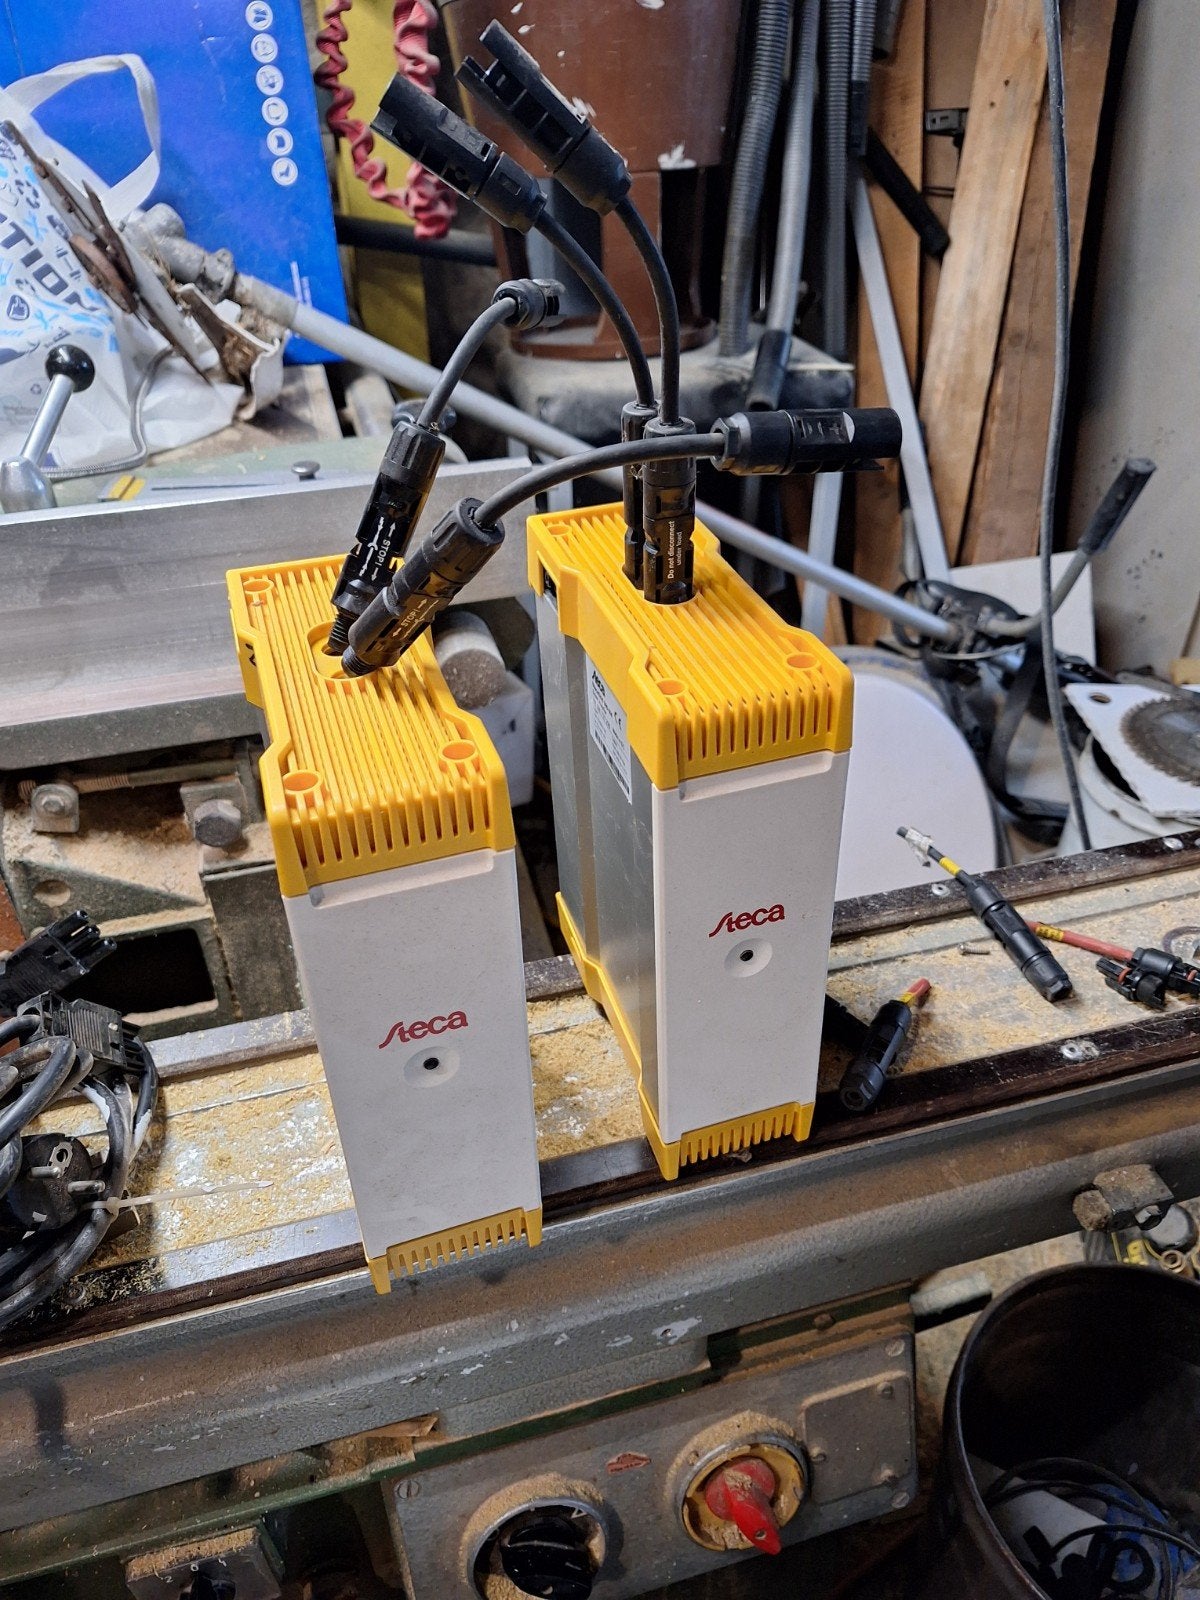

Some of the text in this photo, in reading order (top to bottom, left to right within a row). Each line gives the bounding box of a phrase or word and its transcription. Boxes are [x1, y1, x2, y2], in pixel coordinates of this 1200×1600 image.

[375, 539, 391, 566] STOP!
[667, 521, 676, 579] Do not disconnect
[401, 608, 421, 627] STOP!
